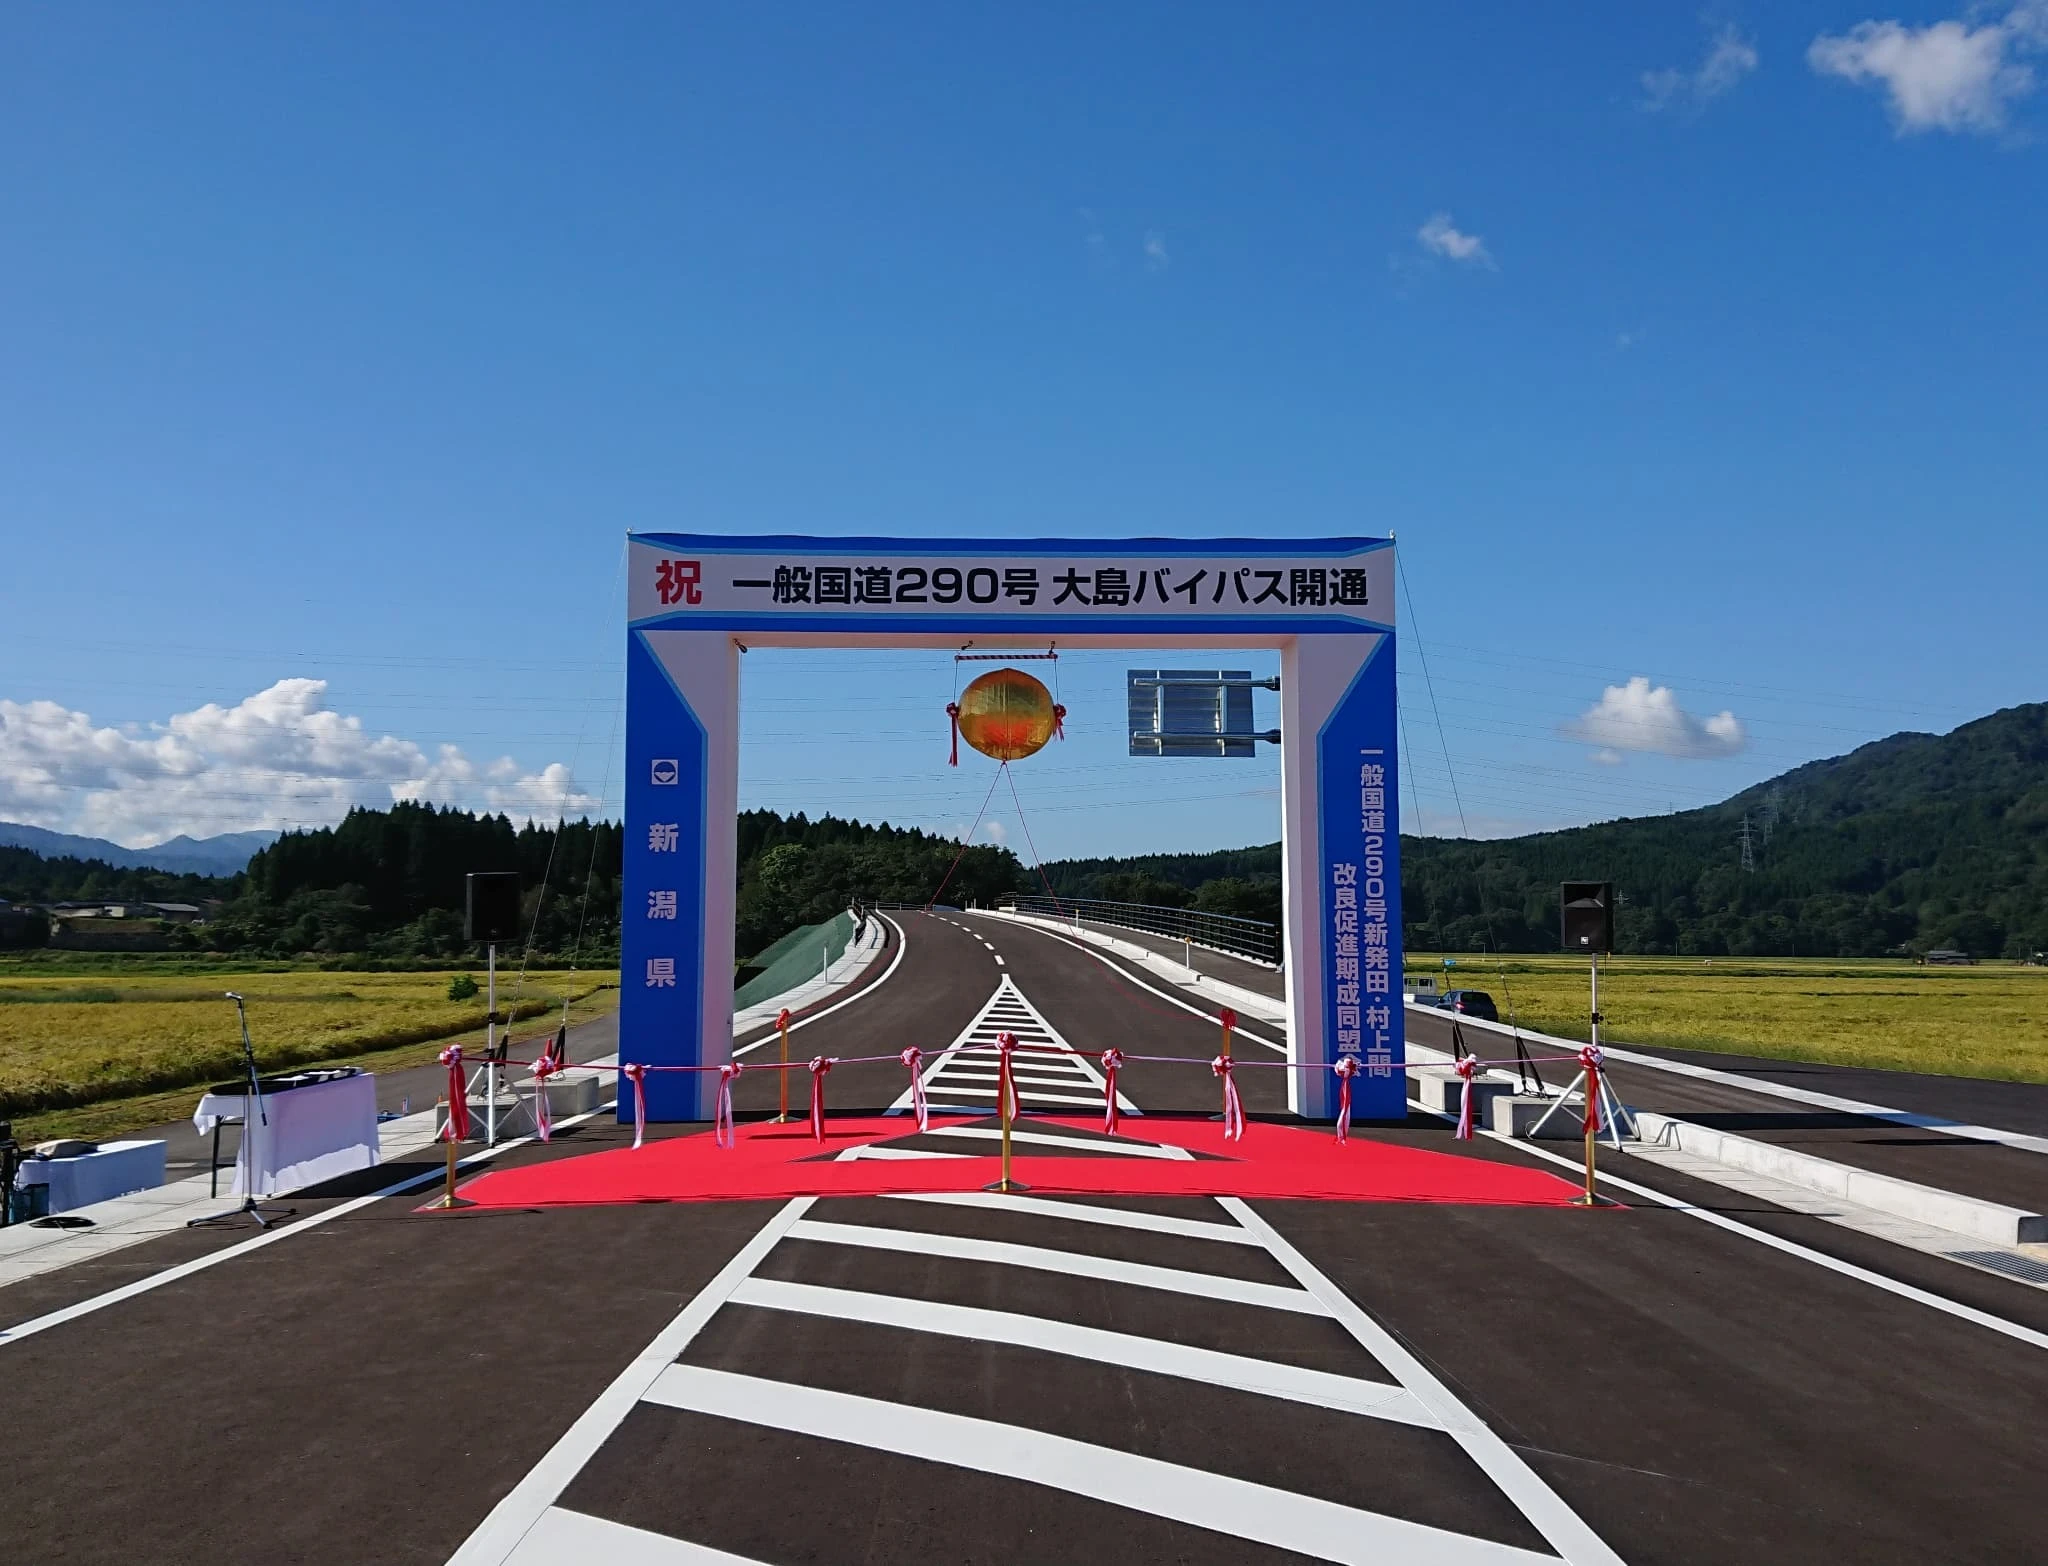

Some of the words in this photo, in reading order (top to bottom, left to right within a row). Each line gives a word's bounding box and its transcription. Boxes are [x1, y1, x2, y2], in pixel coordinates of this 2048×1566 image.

[655, 559, 702, 605] 祝
[732, 565, 1040, 606] 一般国道290号
[1052, 567, 1369, 607] 大島バイパス開通
[645, 823, 679, 988] 新潟県
[1360, 749, 1392, 1078] 一般国道290号新発田・村上間
